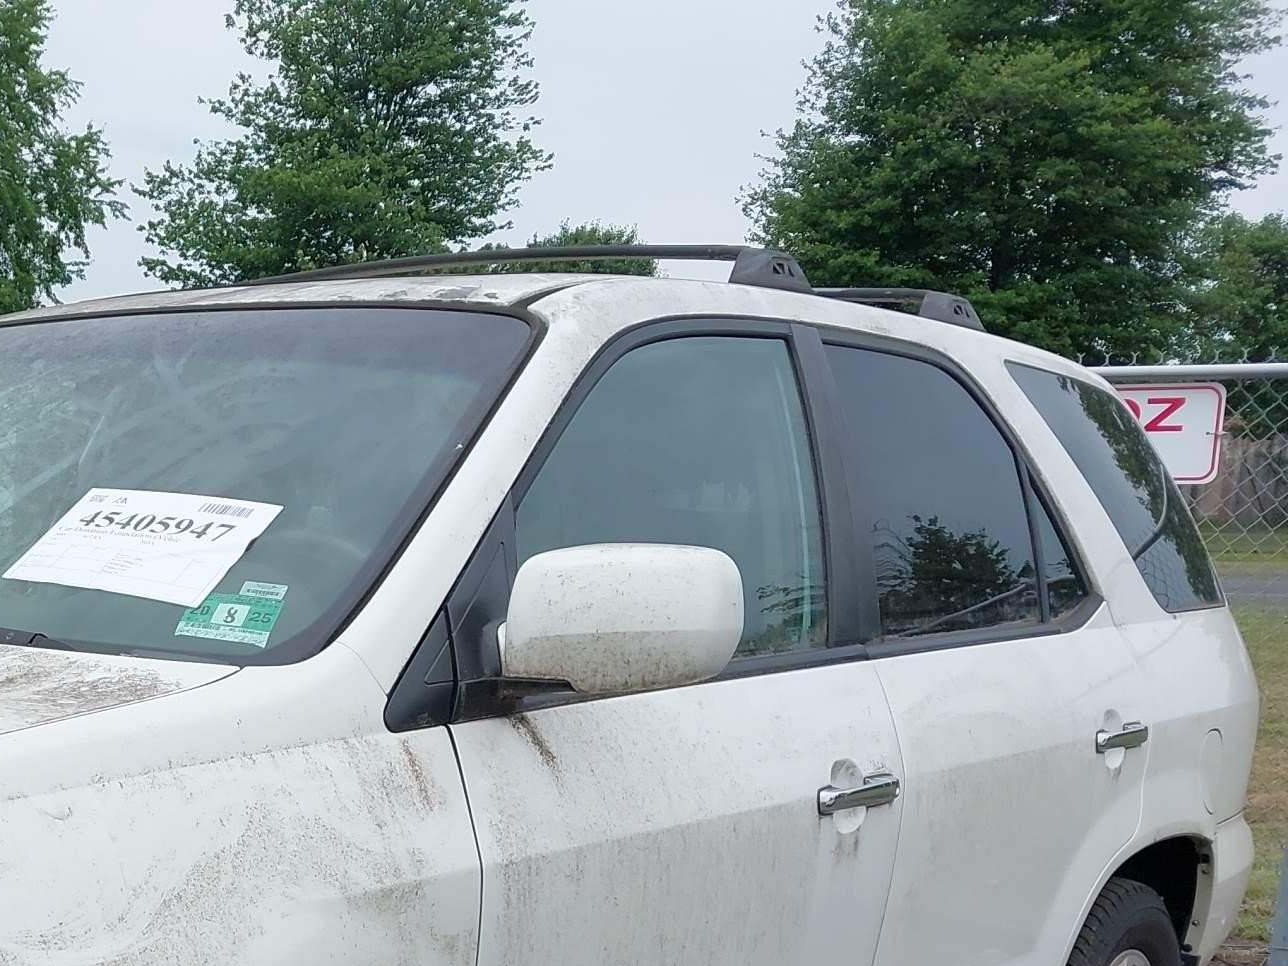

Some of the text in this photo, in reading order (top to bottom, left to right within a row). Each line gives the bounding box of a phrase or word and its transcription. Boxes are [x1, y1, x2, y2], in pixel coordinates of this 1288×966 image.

[79, 510, 238, 542] 45405947
[223, 606, 238, 623] 8
[248, 611, 273, 624] 25
